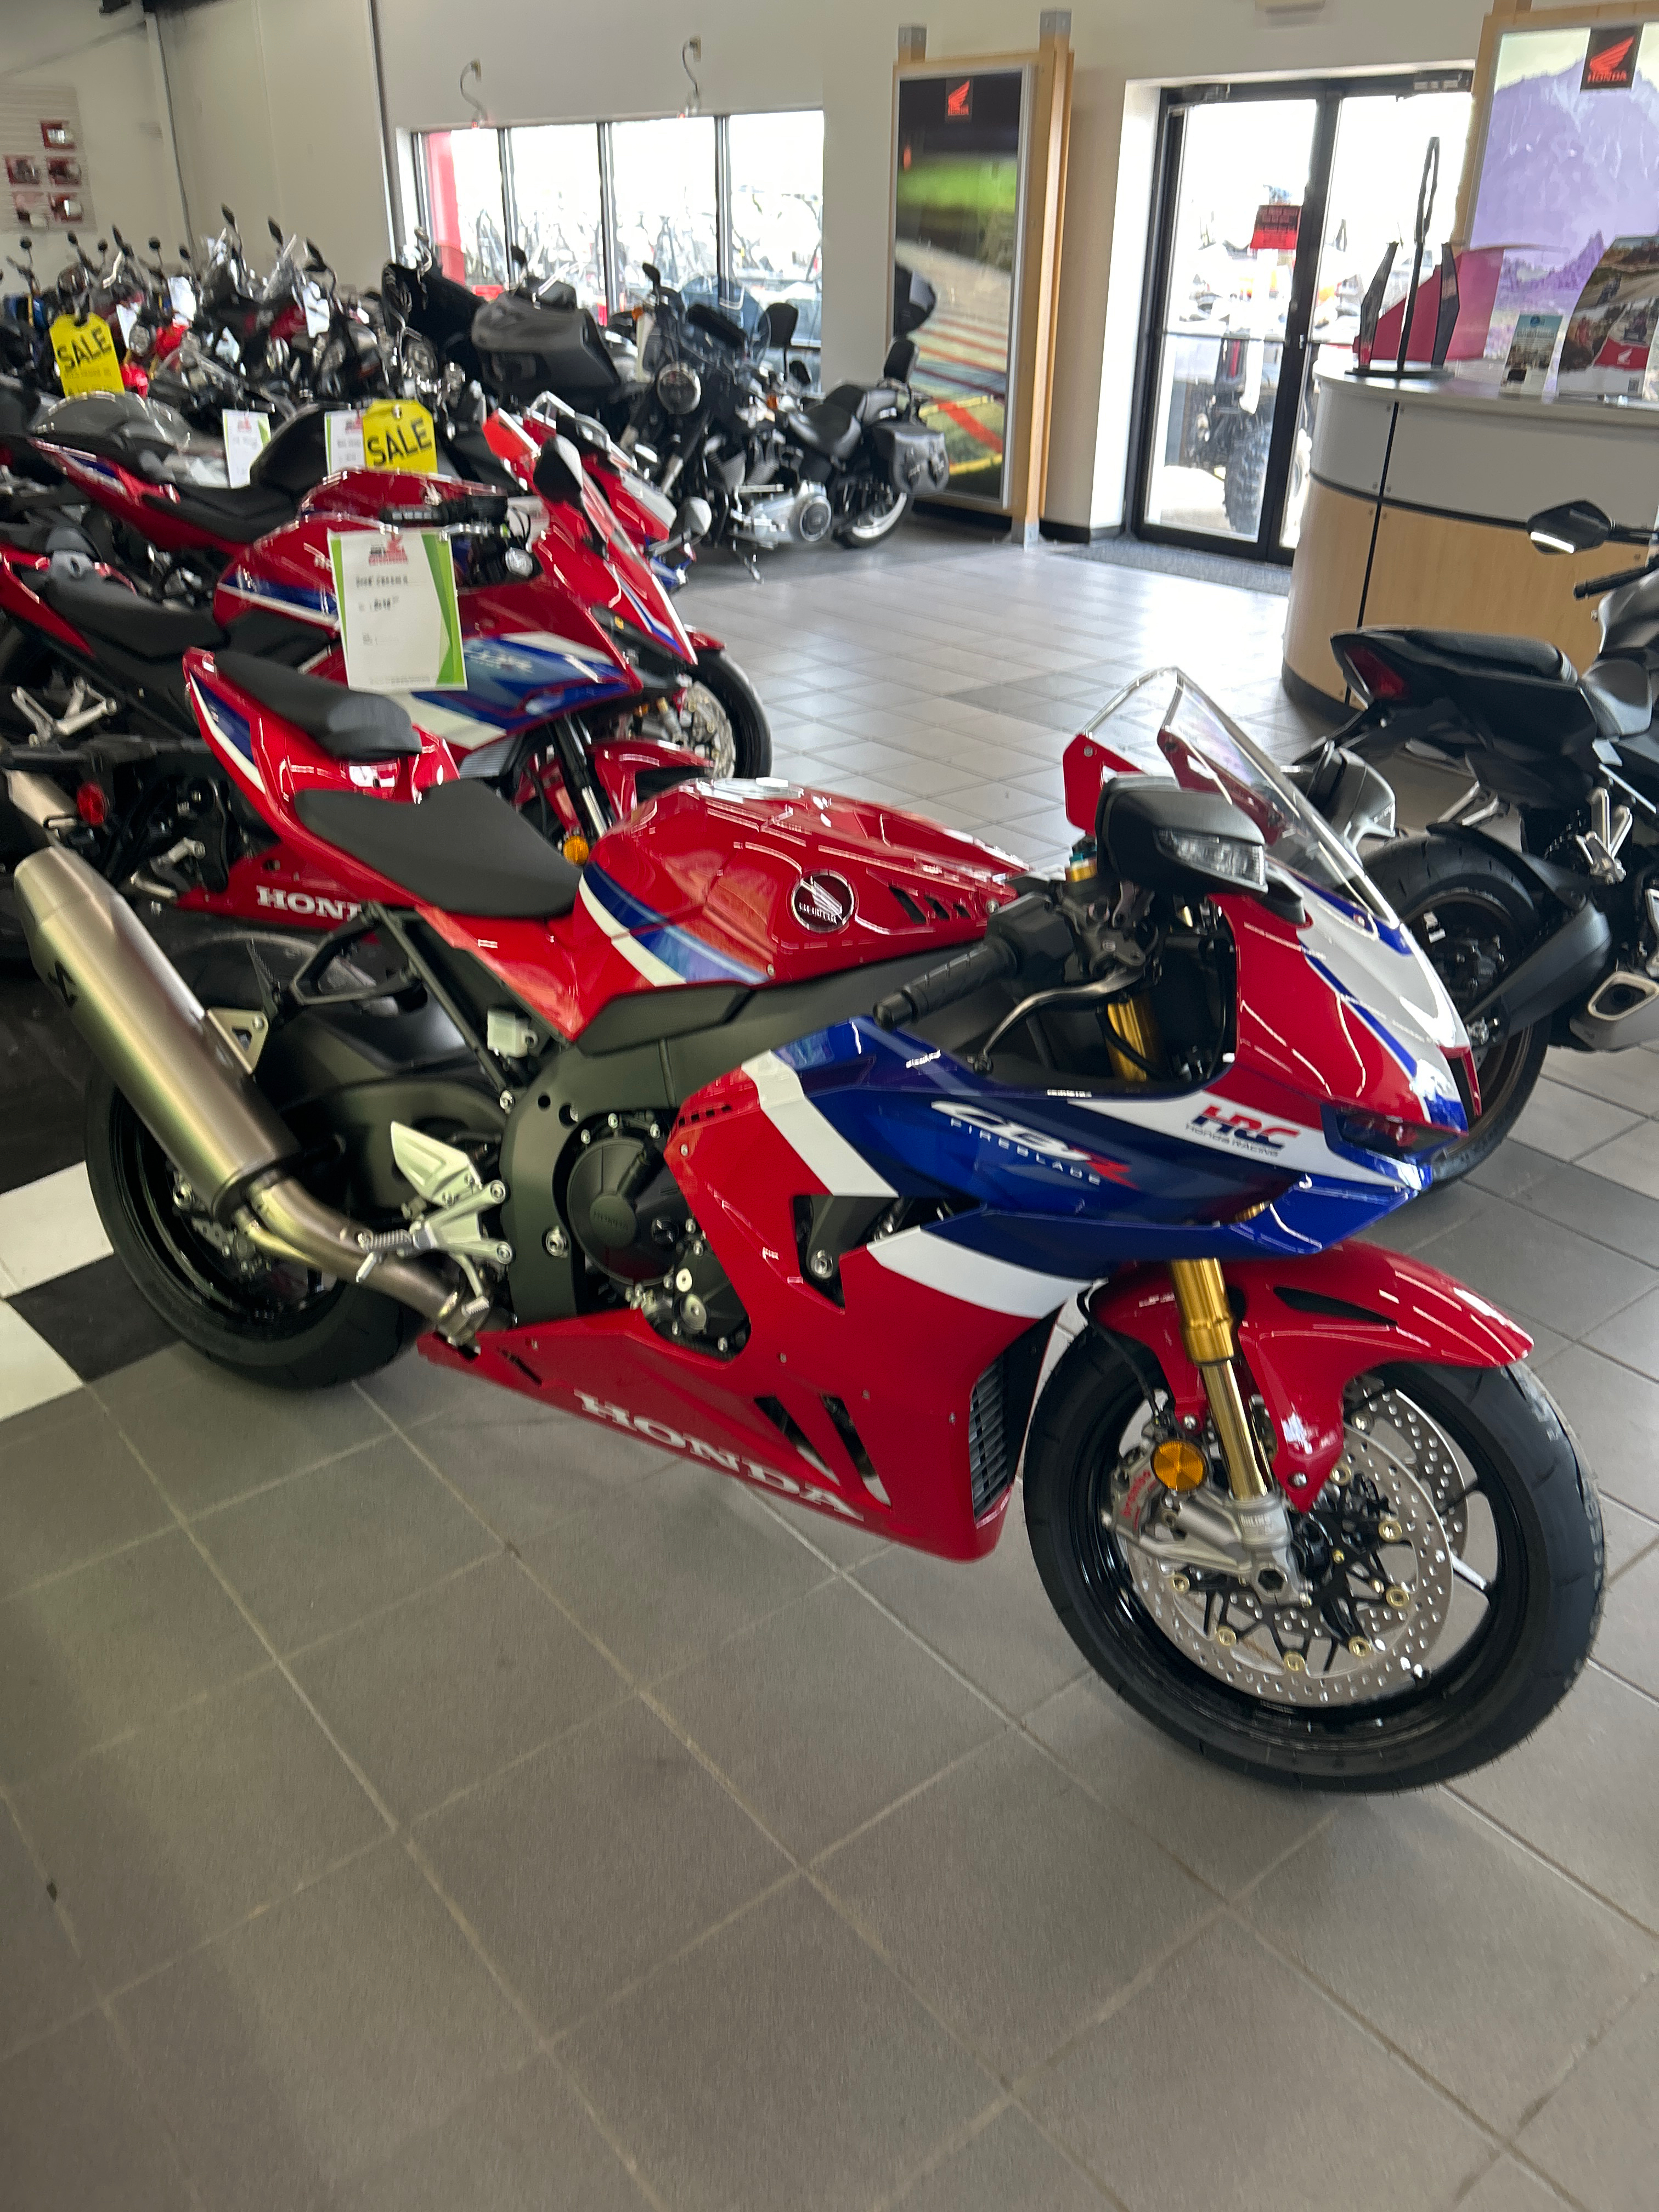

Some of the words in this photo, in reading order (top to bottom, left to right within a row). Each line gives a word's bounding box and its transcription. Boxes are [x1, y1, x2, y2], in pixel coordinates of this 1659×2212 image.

[1587, 70, 1627, 83] HONDA
[57, 326, 112, 371] SALE
[368, 416, 432, 466] SALE
[256, 885, 362, 922] HON
[1192, 1105, 1301, 1149] HRC
[950, 1117, 1101, 1186] FIREBLADE
[573, 1389, 865, 1522] HONDA
